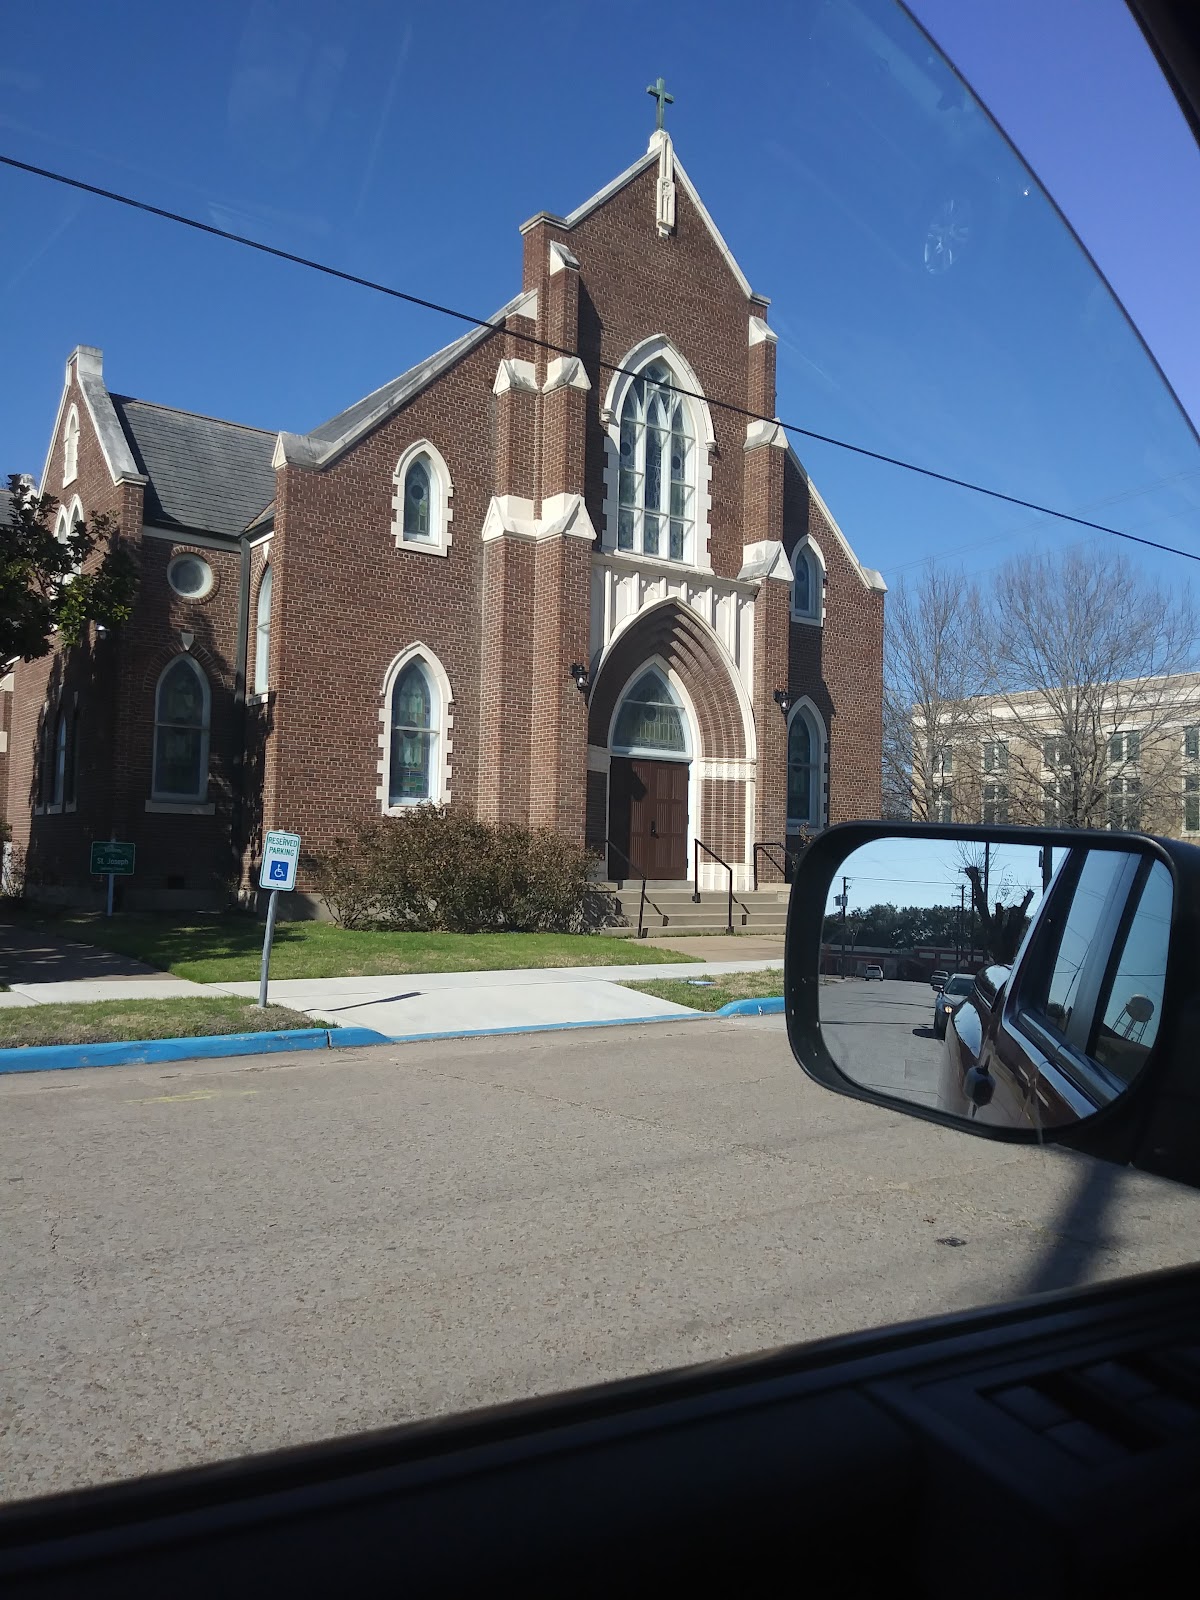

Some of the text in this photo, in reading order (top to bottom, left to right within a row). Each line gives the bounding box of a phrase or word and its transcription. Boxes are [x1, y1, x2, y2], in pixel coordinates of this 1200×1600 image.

[268, 836, 297, 847] RESERVED
[269, 847, 294, 856] PARKING
[107, 858, 129, 867] Joseph
